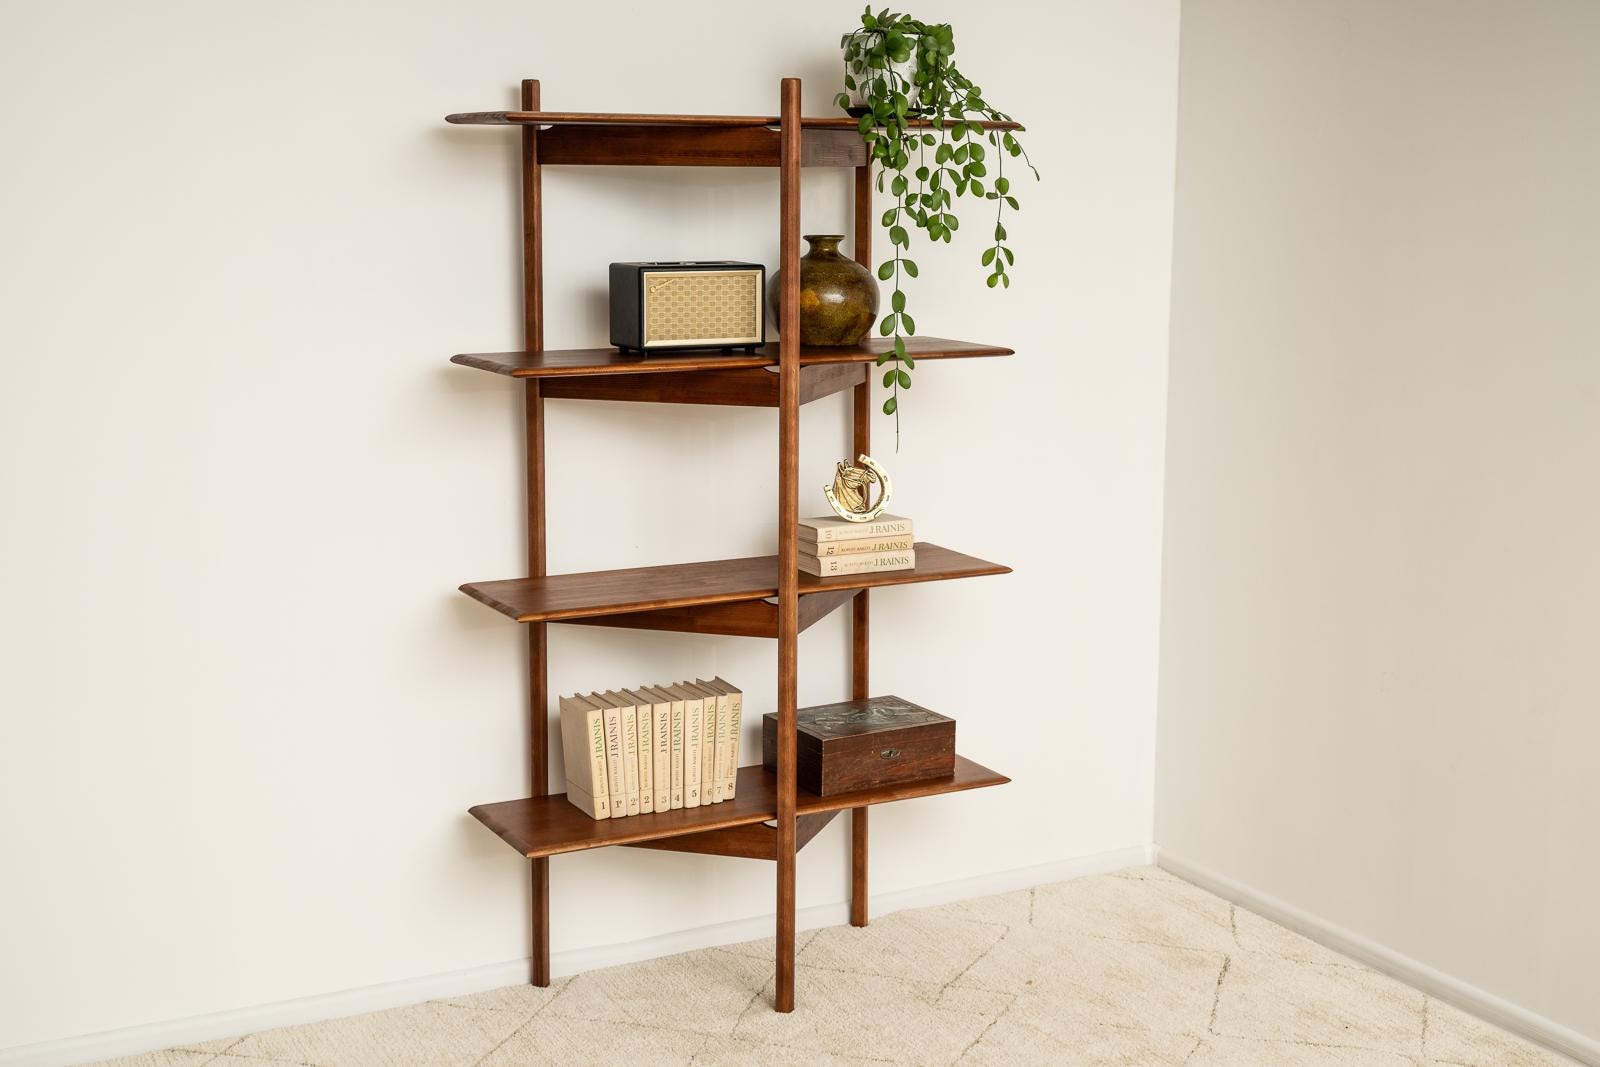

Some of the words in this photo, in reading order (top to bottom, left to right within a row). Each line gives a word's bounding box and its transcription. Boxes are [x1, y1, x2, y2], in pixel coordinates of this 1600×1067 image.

[827, 546, 835, 555] 12
[830, 561, 838, 571] 13
[717, 786, 721, 794] 7
[727, 782, 733, 790] 8
[691, 789, 697, 797] 5
[707, 788, 713, 796] 6
[644, 796, 650, 804] 2
[661, 796, 667, 804] 3
[601, 801, 605, 810] 1
